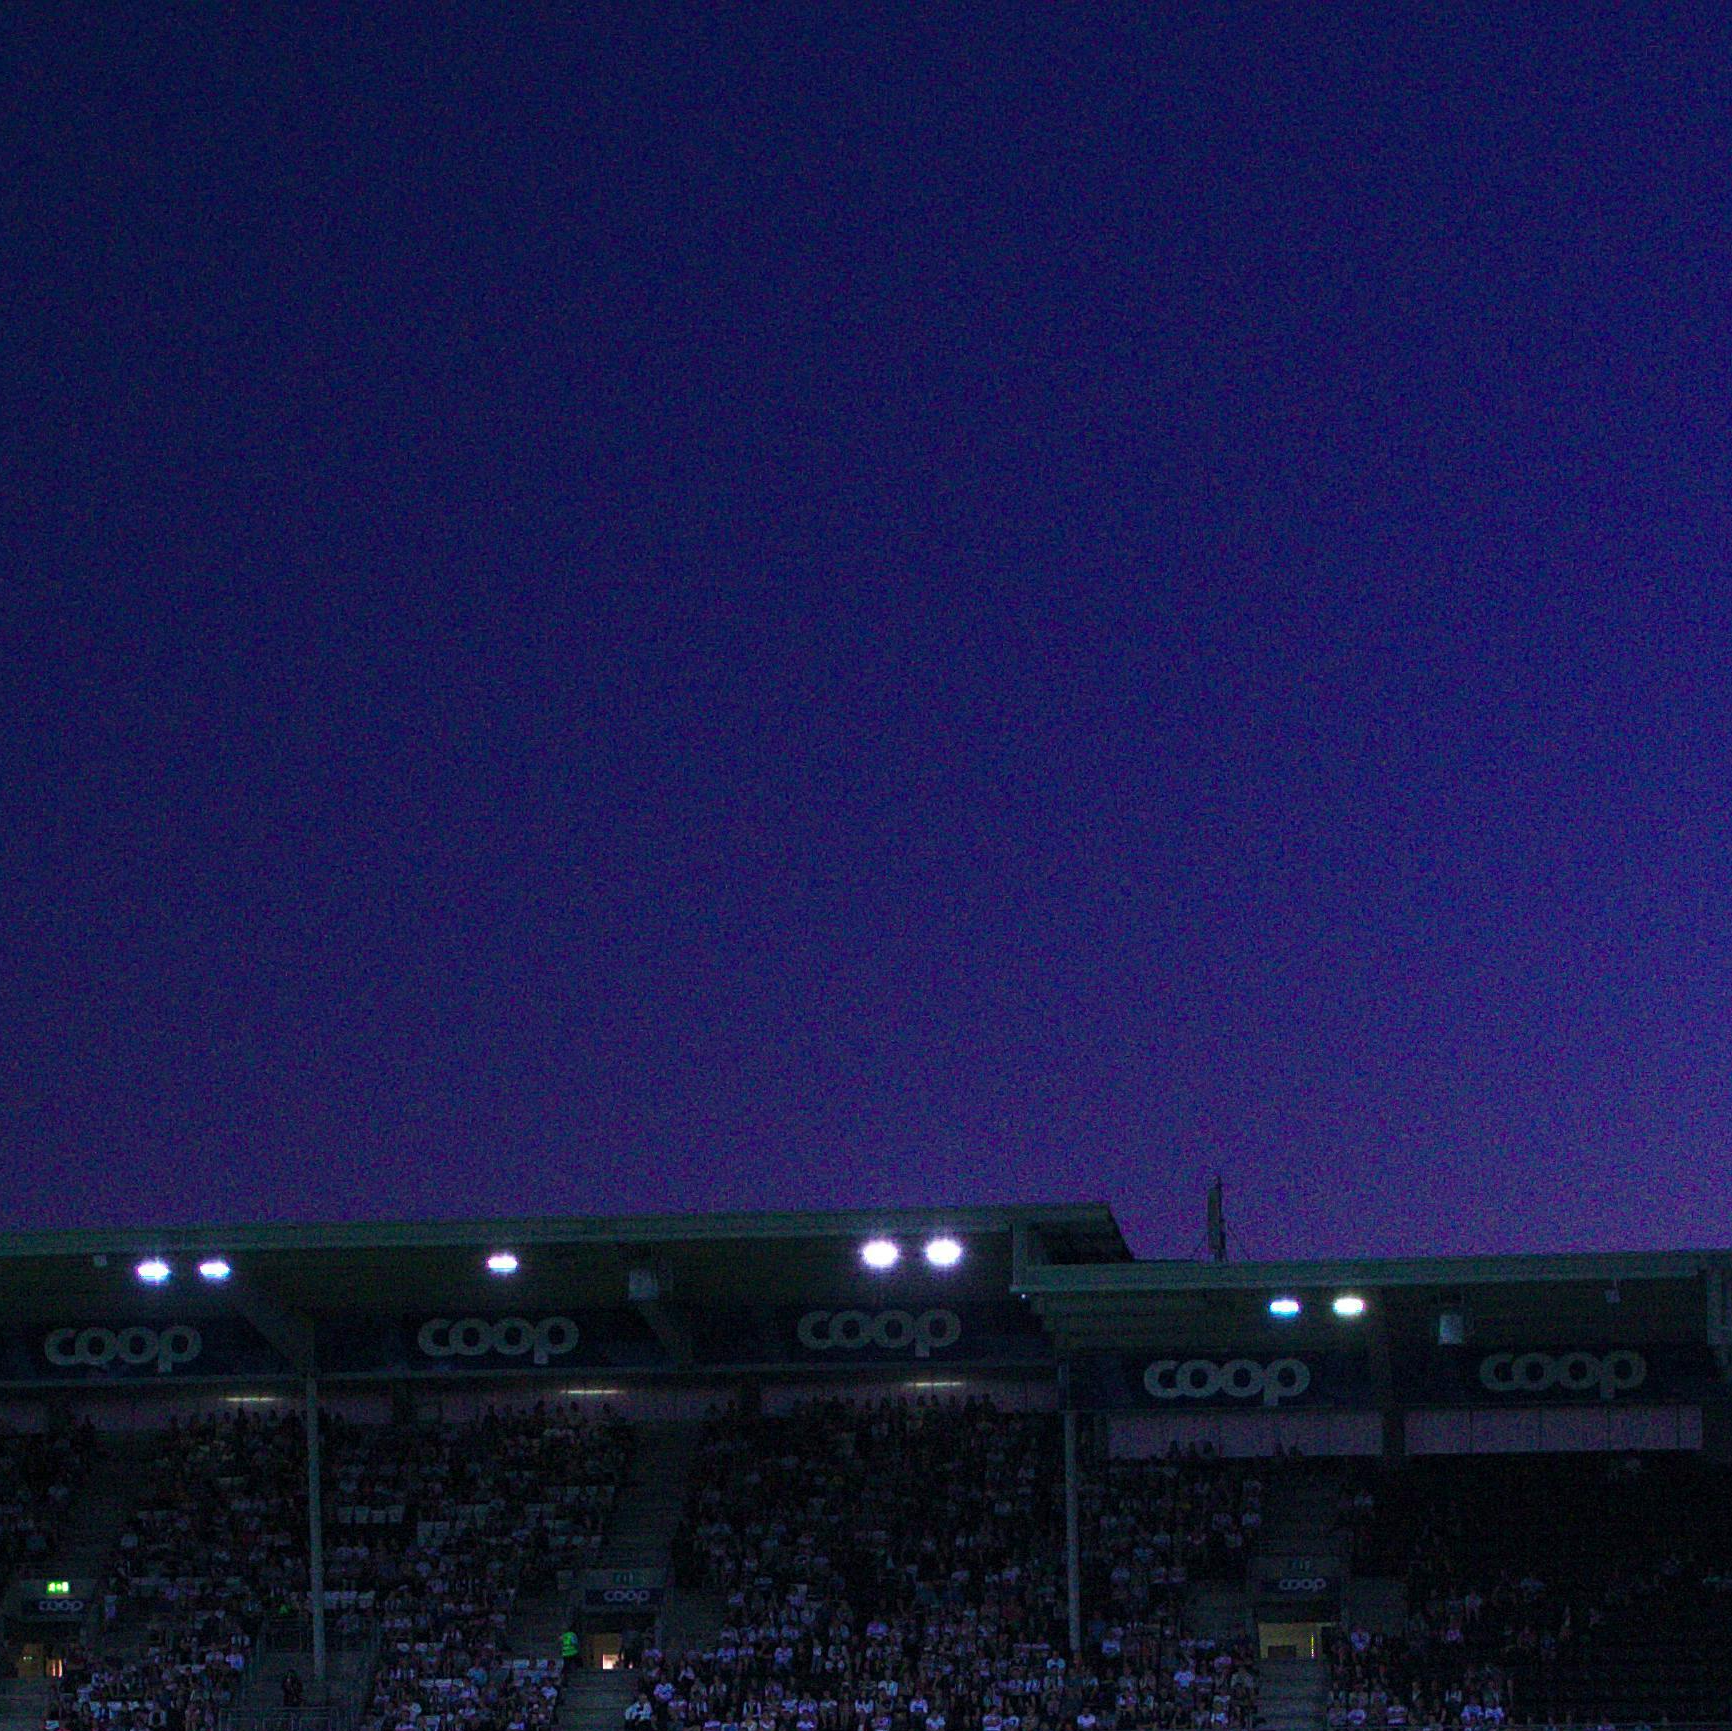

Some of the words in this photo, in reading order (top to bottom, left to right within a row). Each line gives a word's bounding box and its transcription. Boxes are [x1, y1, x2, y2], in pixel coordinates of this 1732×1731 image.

[44, 1323, 201, 1373] coop
[418, 1317, 579, 1364] coop
[798, 1308, 961, 1357] coop
[1144, 1357, 1310, 1407] coop
[1480, 1350, 1647, 1399] coop
